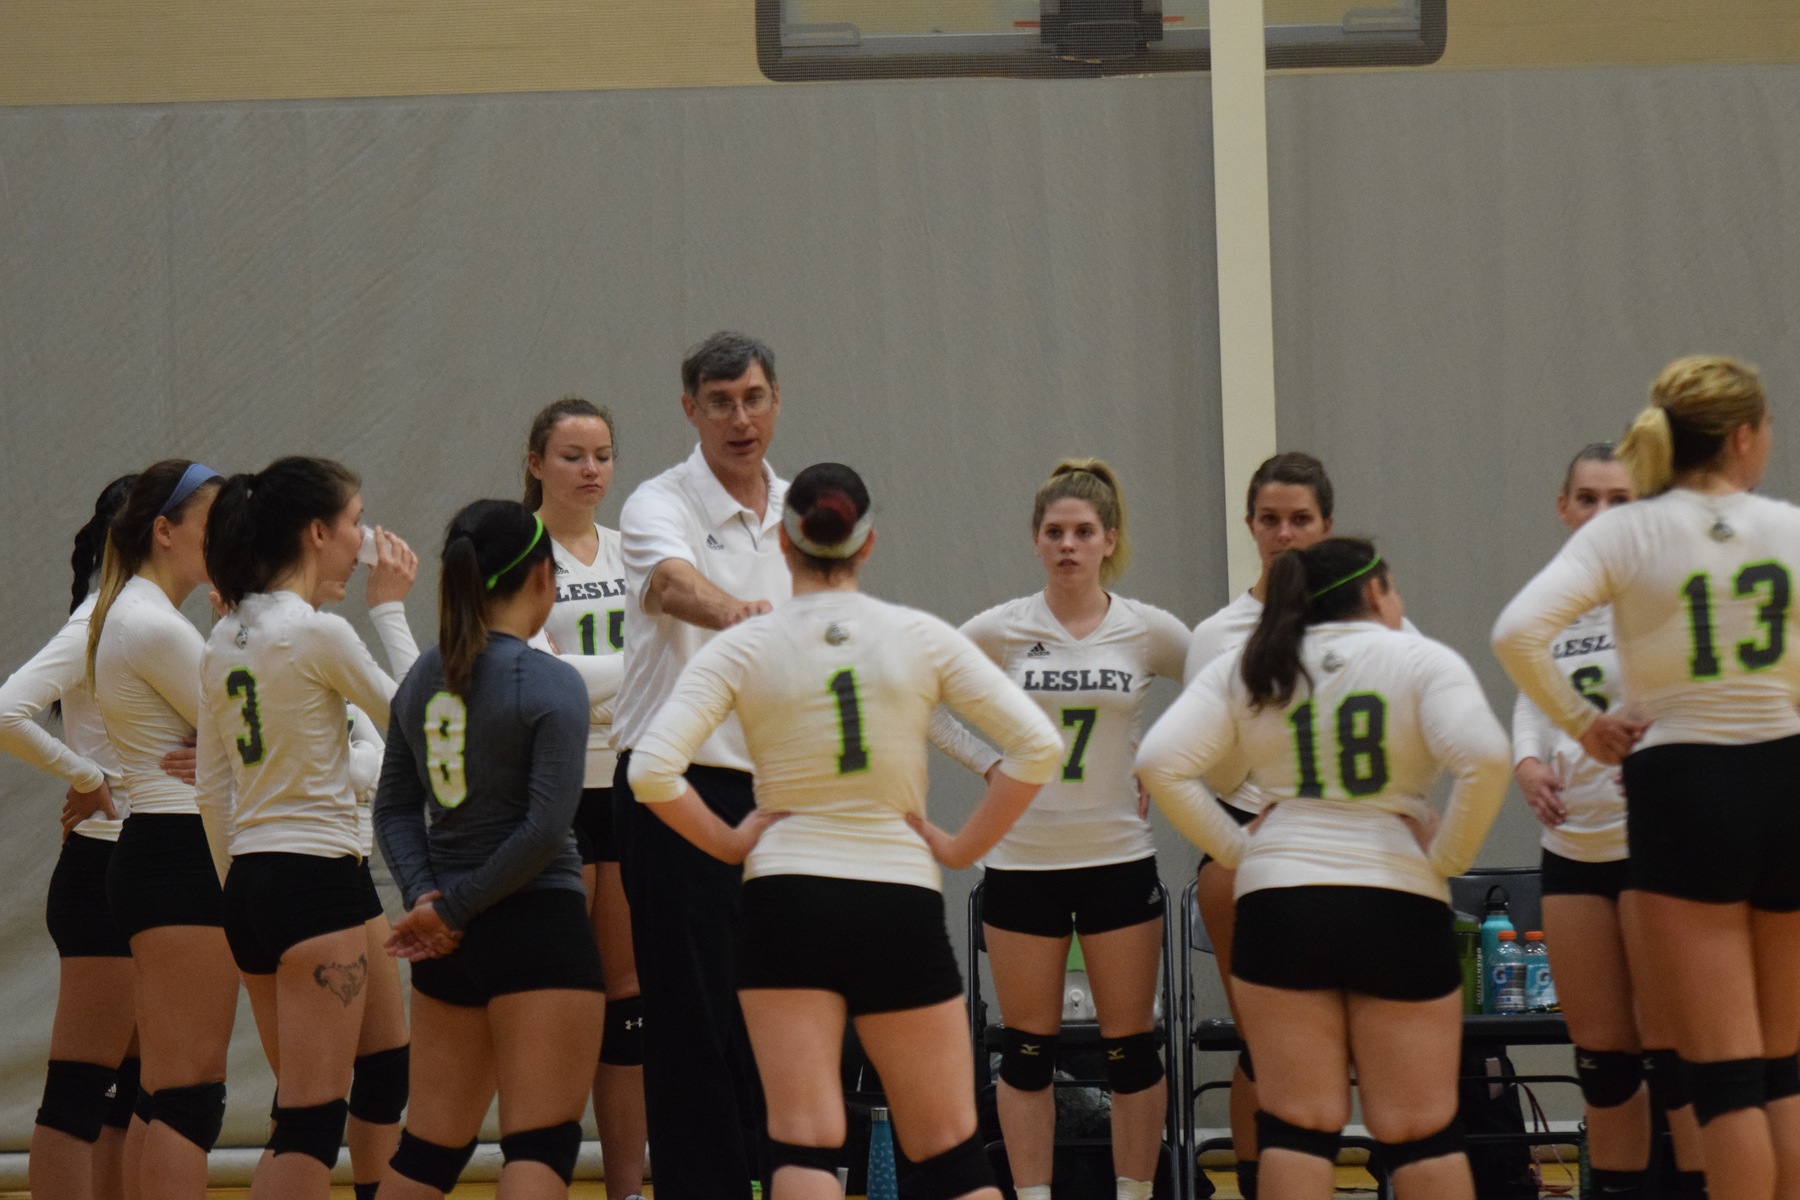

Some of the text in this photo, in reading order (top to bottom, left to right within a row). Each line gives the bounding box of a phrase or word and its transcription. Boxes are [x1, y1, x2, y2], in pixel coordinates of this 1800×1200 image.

[1681, 559, 1791, 681] 13
[225, 666, 265, 768] 3
[826, 665, 870, 777] 1
[1023, 669, 1133, 693] LESLEY
[424, 691, 467, 808] 8
[1061, 706, 1097, 783] 7
[1286, 689, 1389, 799] 18
